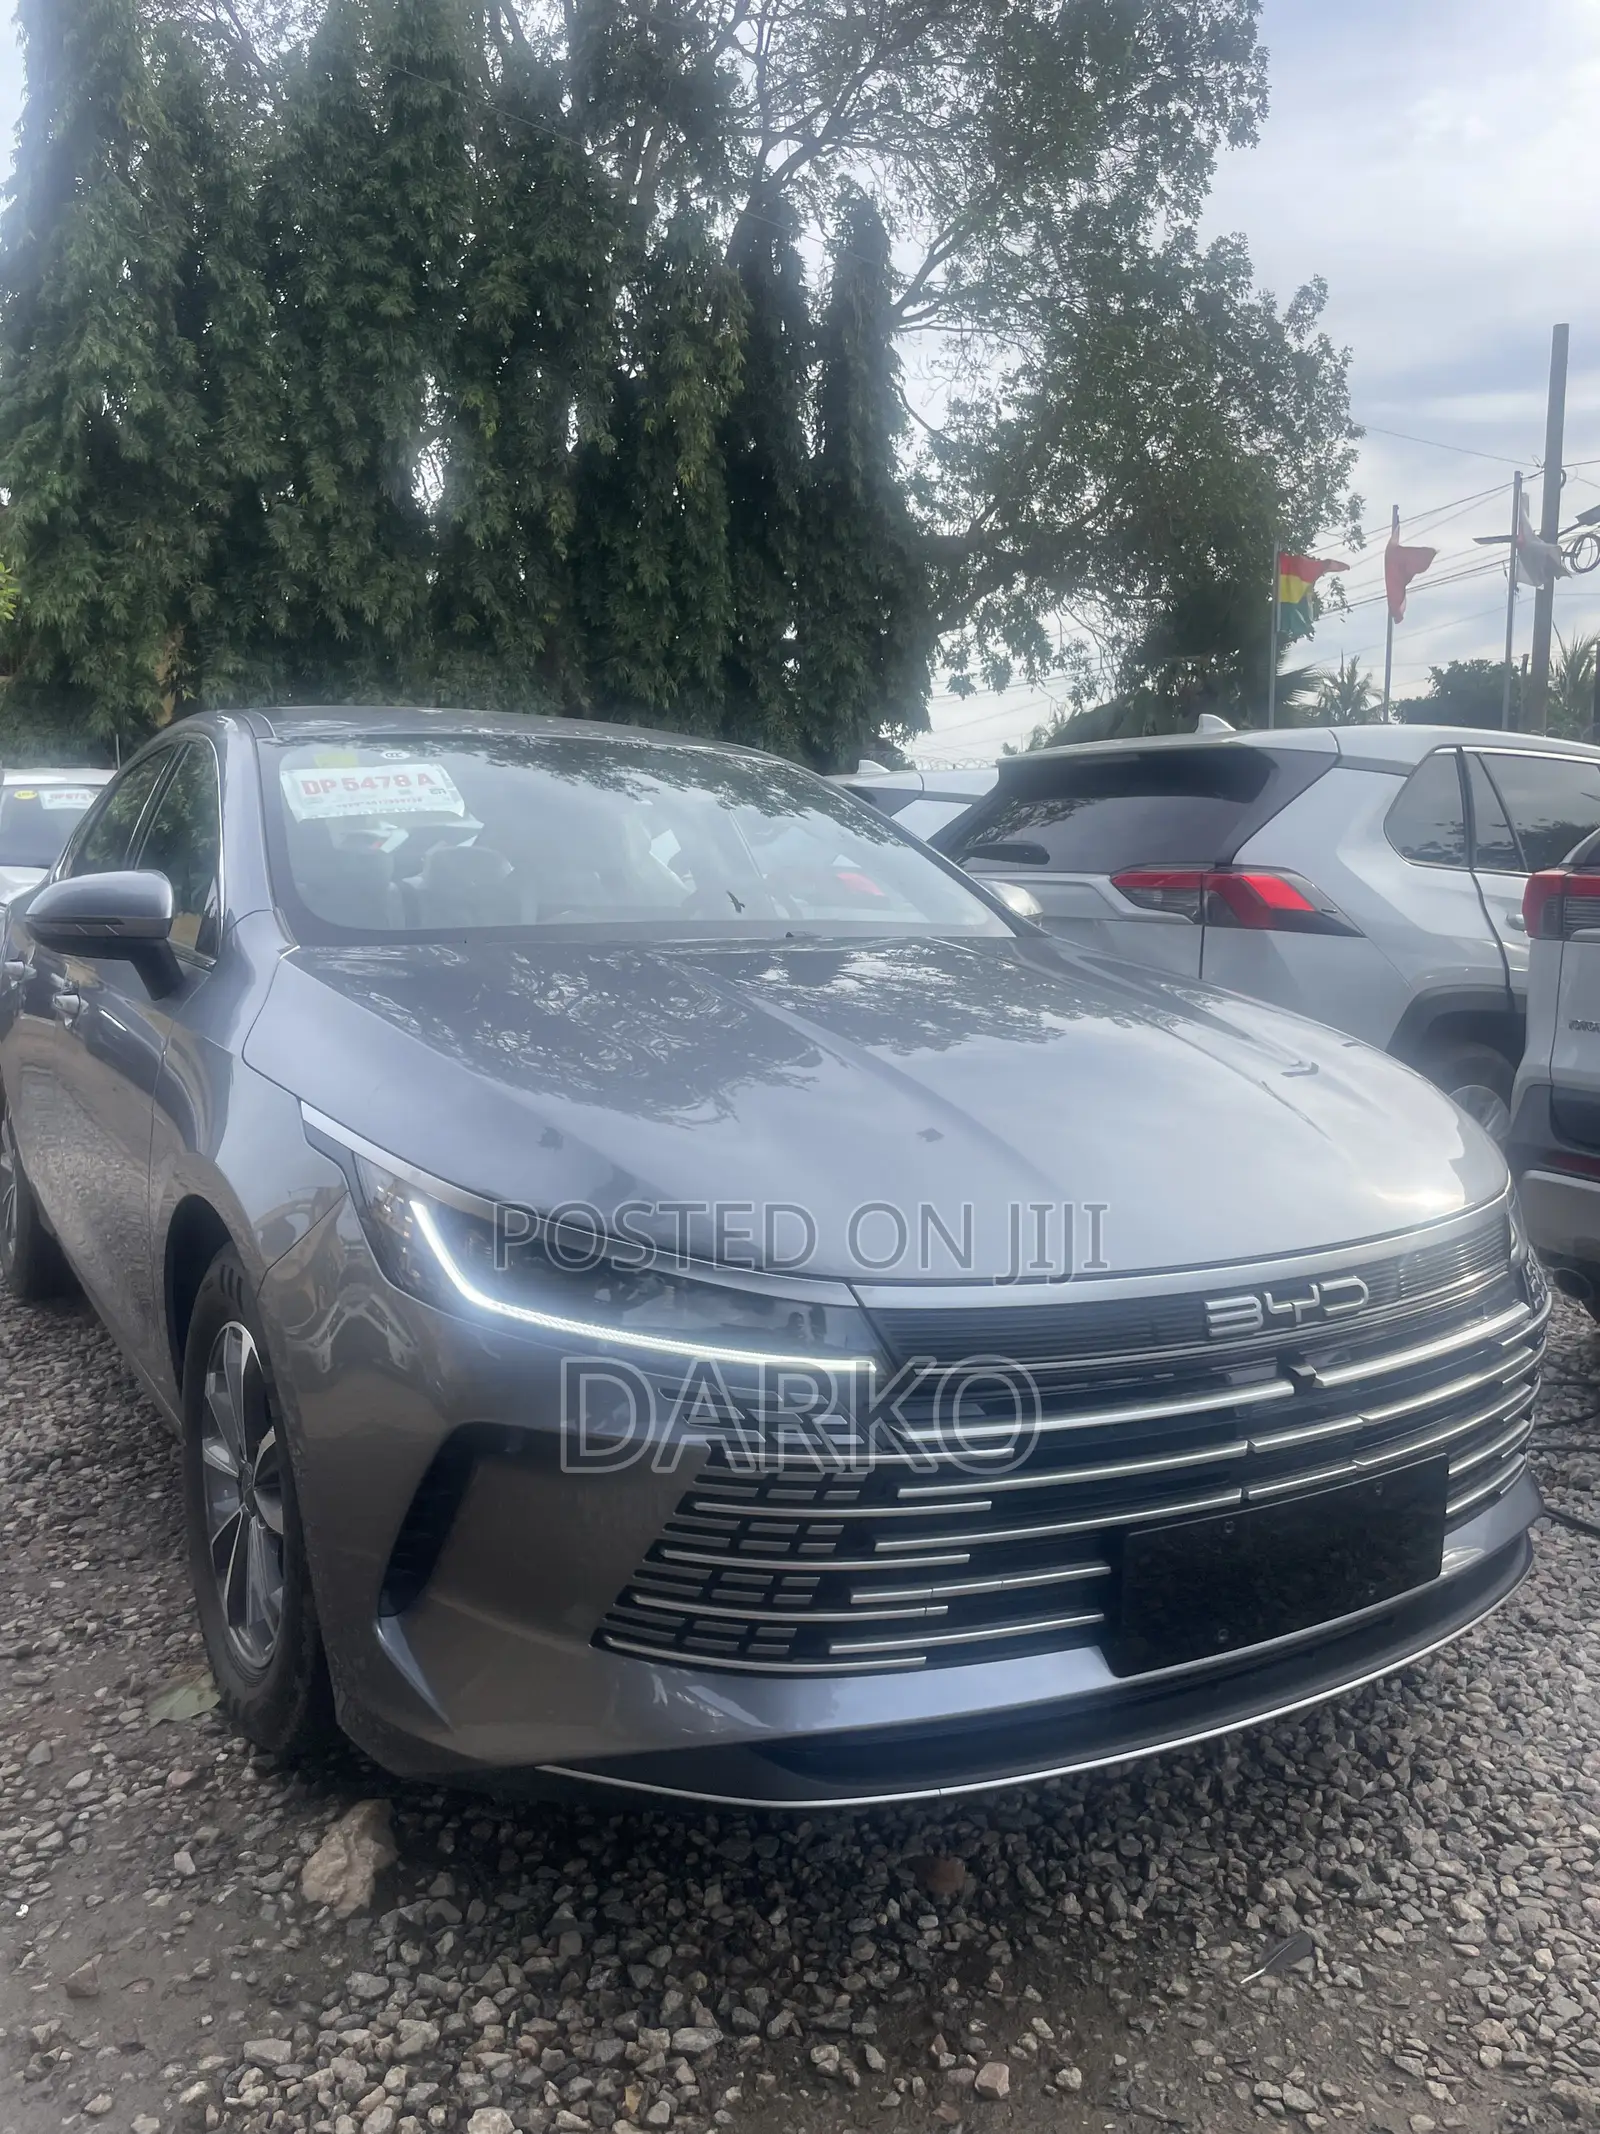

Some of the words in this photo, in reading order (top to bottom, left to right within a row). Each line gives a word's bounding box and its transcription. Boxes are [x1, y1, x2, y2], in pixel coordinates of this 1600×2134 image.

[300, 778, 337, 796] DP
[341, 774, 412, 792] 5478
[417, 773, 436, 787] A
[1204, 1275, 1370, 1337] BYD
